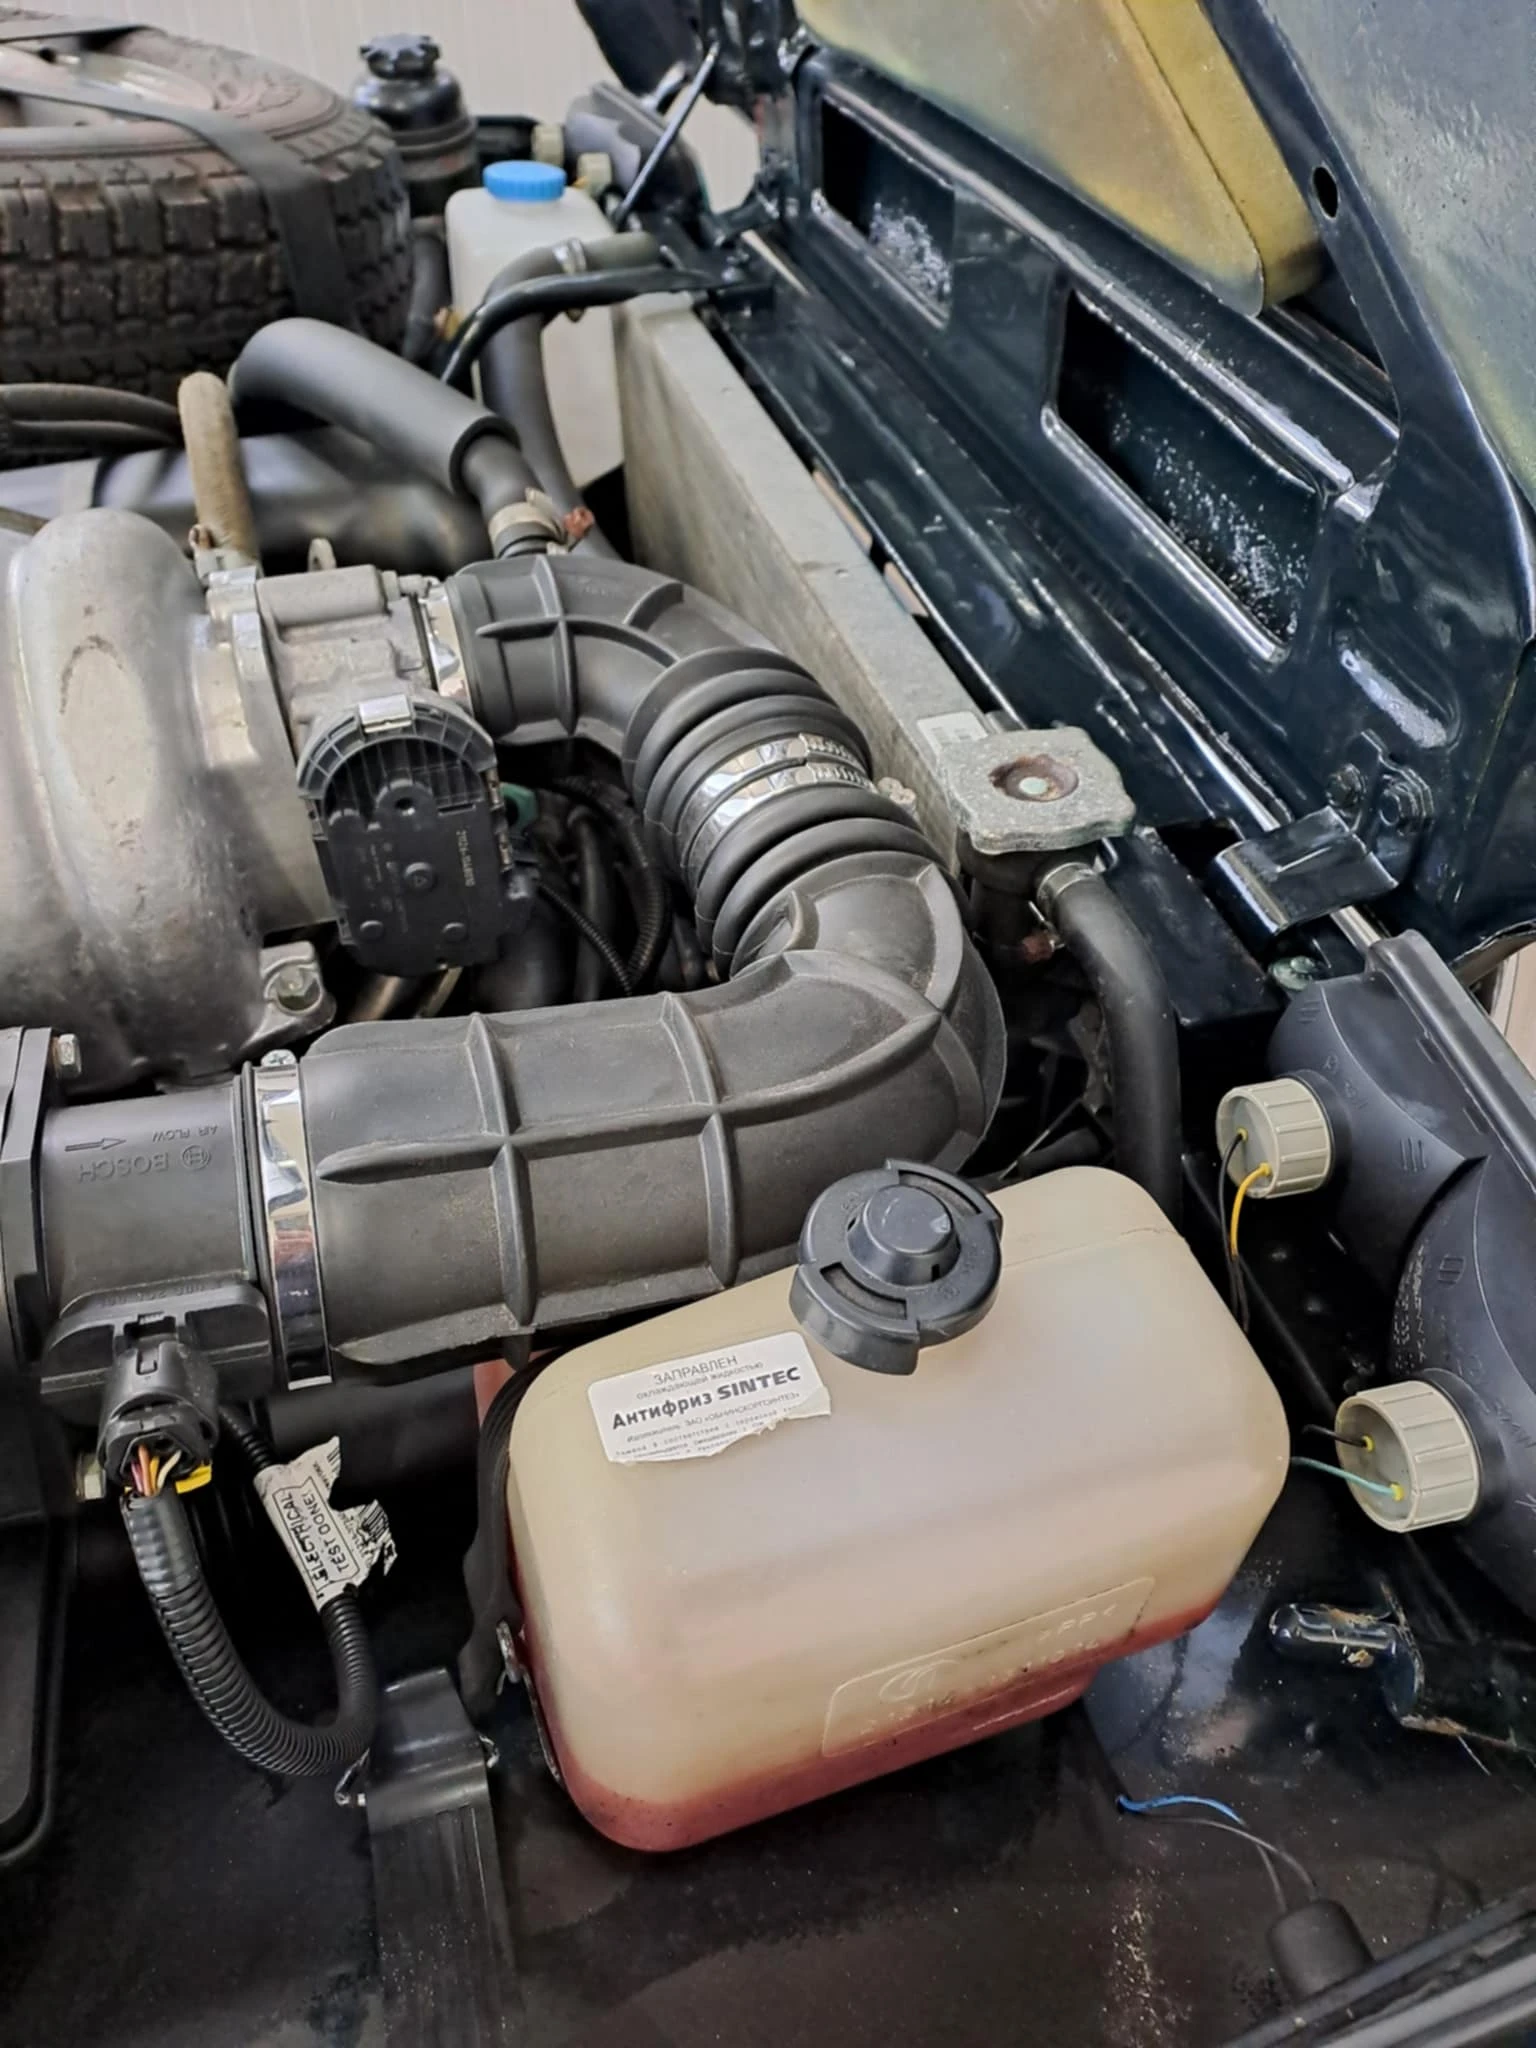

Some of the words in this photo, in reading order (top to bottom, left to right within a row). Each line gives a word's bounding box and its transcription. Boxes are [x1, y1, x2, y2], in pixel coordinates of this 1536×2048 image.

[78, 1152, 170, 1184] BOSCH
[653, 1355, 738, 1385] ЗАПРАВЛЕН
[612, 1392, 713, 1431] Антифриз
[717, 1366, 801, 1401] SINTEC
[323, 1537, 350, 1574] TEST
